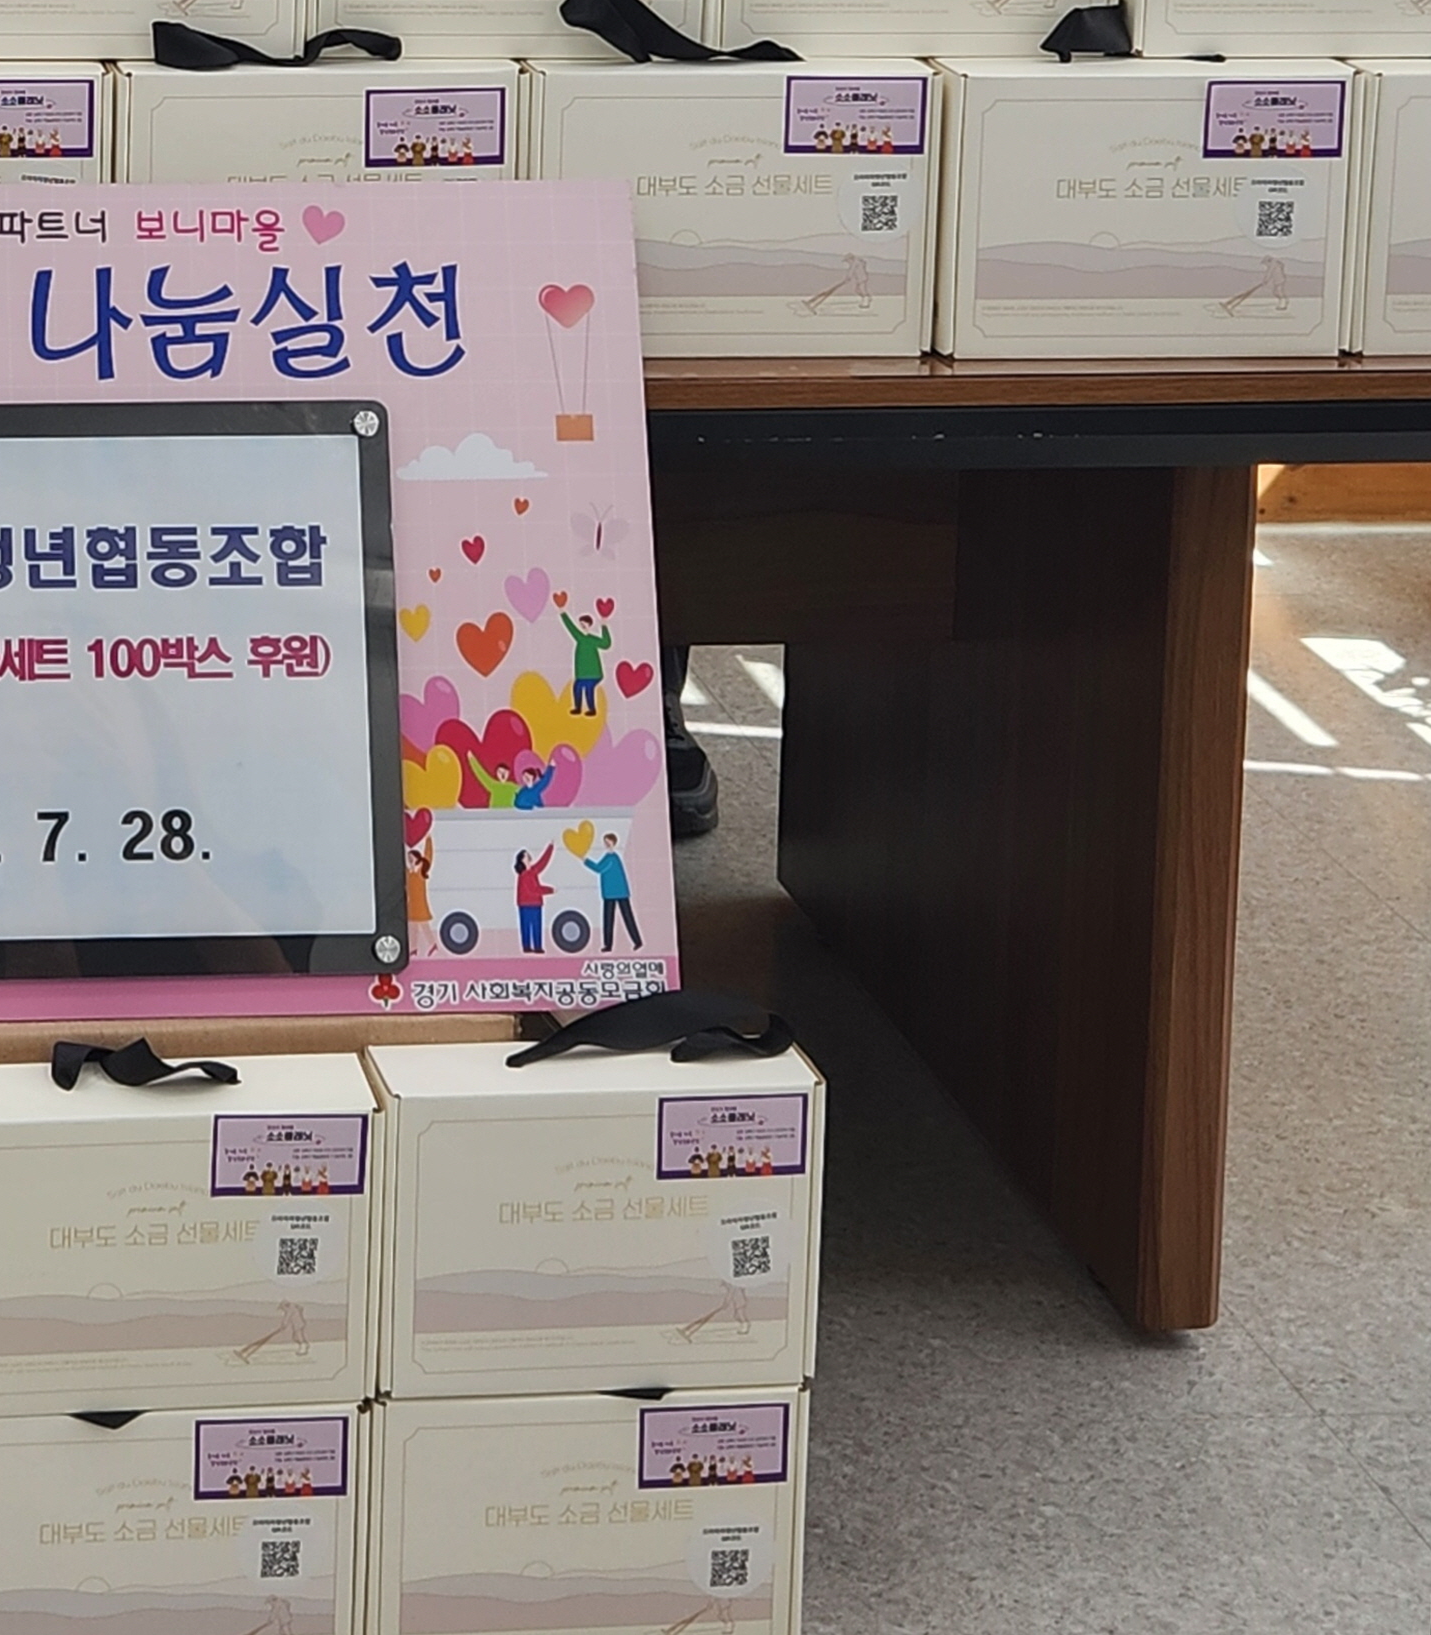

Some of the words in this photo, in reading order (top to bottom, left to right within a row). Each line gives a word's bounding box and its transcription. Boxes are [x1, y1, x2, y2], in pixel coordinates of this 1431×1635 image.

[637, 175, 699, 198] 대부도
[704, 174, 746, 197] 소금
[752, 174, 833, 196] 선물세트
[1056, 178, 1117, 200] 대부도
[1123, 178, 1165, 199] 소금
[135, 206, 286, 252] 보니마을
[30, 263, 466, 382] 나눔실천
[87, 636, 234, 681] 100박스
[246, 634, 332, 680] 후원)
[36, 810, 87, 863] 7.
[120, 808, 211, 862] 28.
[412, 981, 458, 1008] 경기
[498, 1201, 565, 1226] 대부도
[570, 1198, 615, 1223] 소금
[621, 1195, 709, 1220] 선물세트
[49, 1225, 117, 1250] 대부도
[124, 1223, 168, 1247] 소금
[485, 1504, 550, 1528] 대부도
[558, 1502, 600, 1526] 소금
[607, 1499, 695, 1523] 선물세트
[39, 1521, 107, 1545] 대부도
[113, 1519, 158, 1542] 소금
